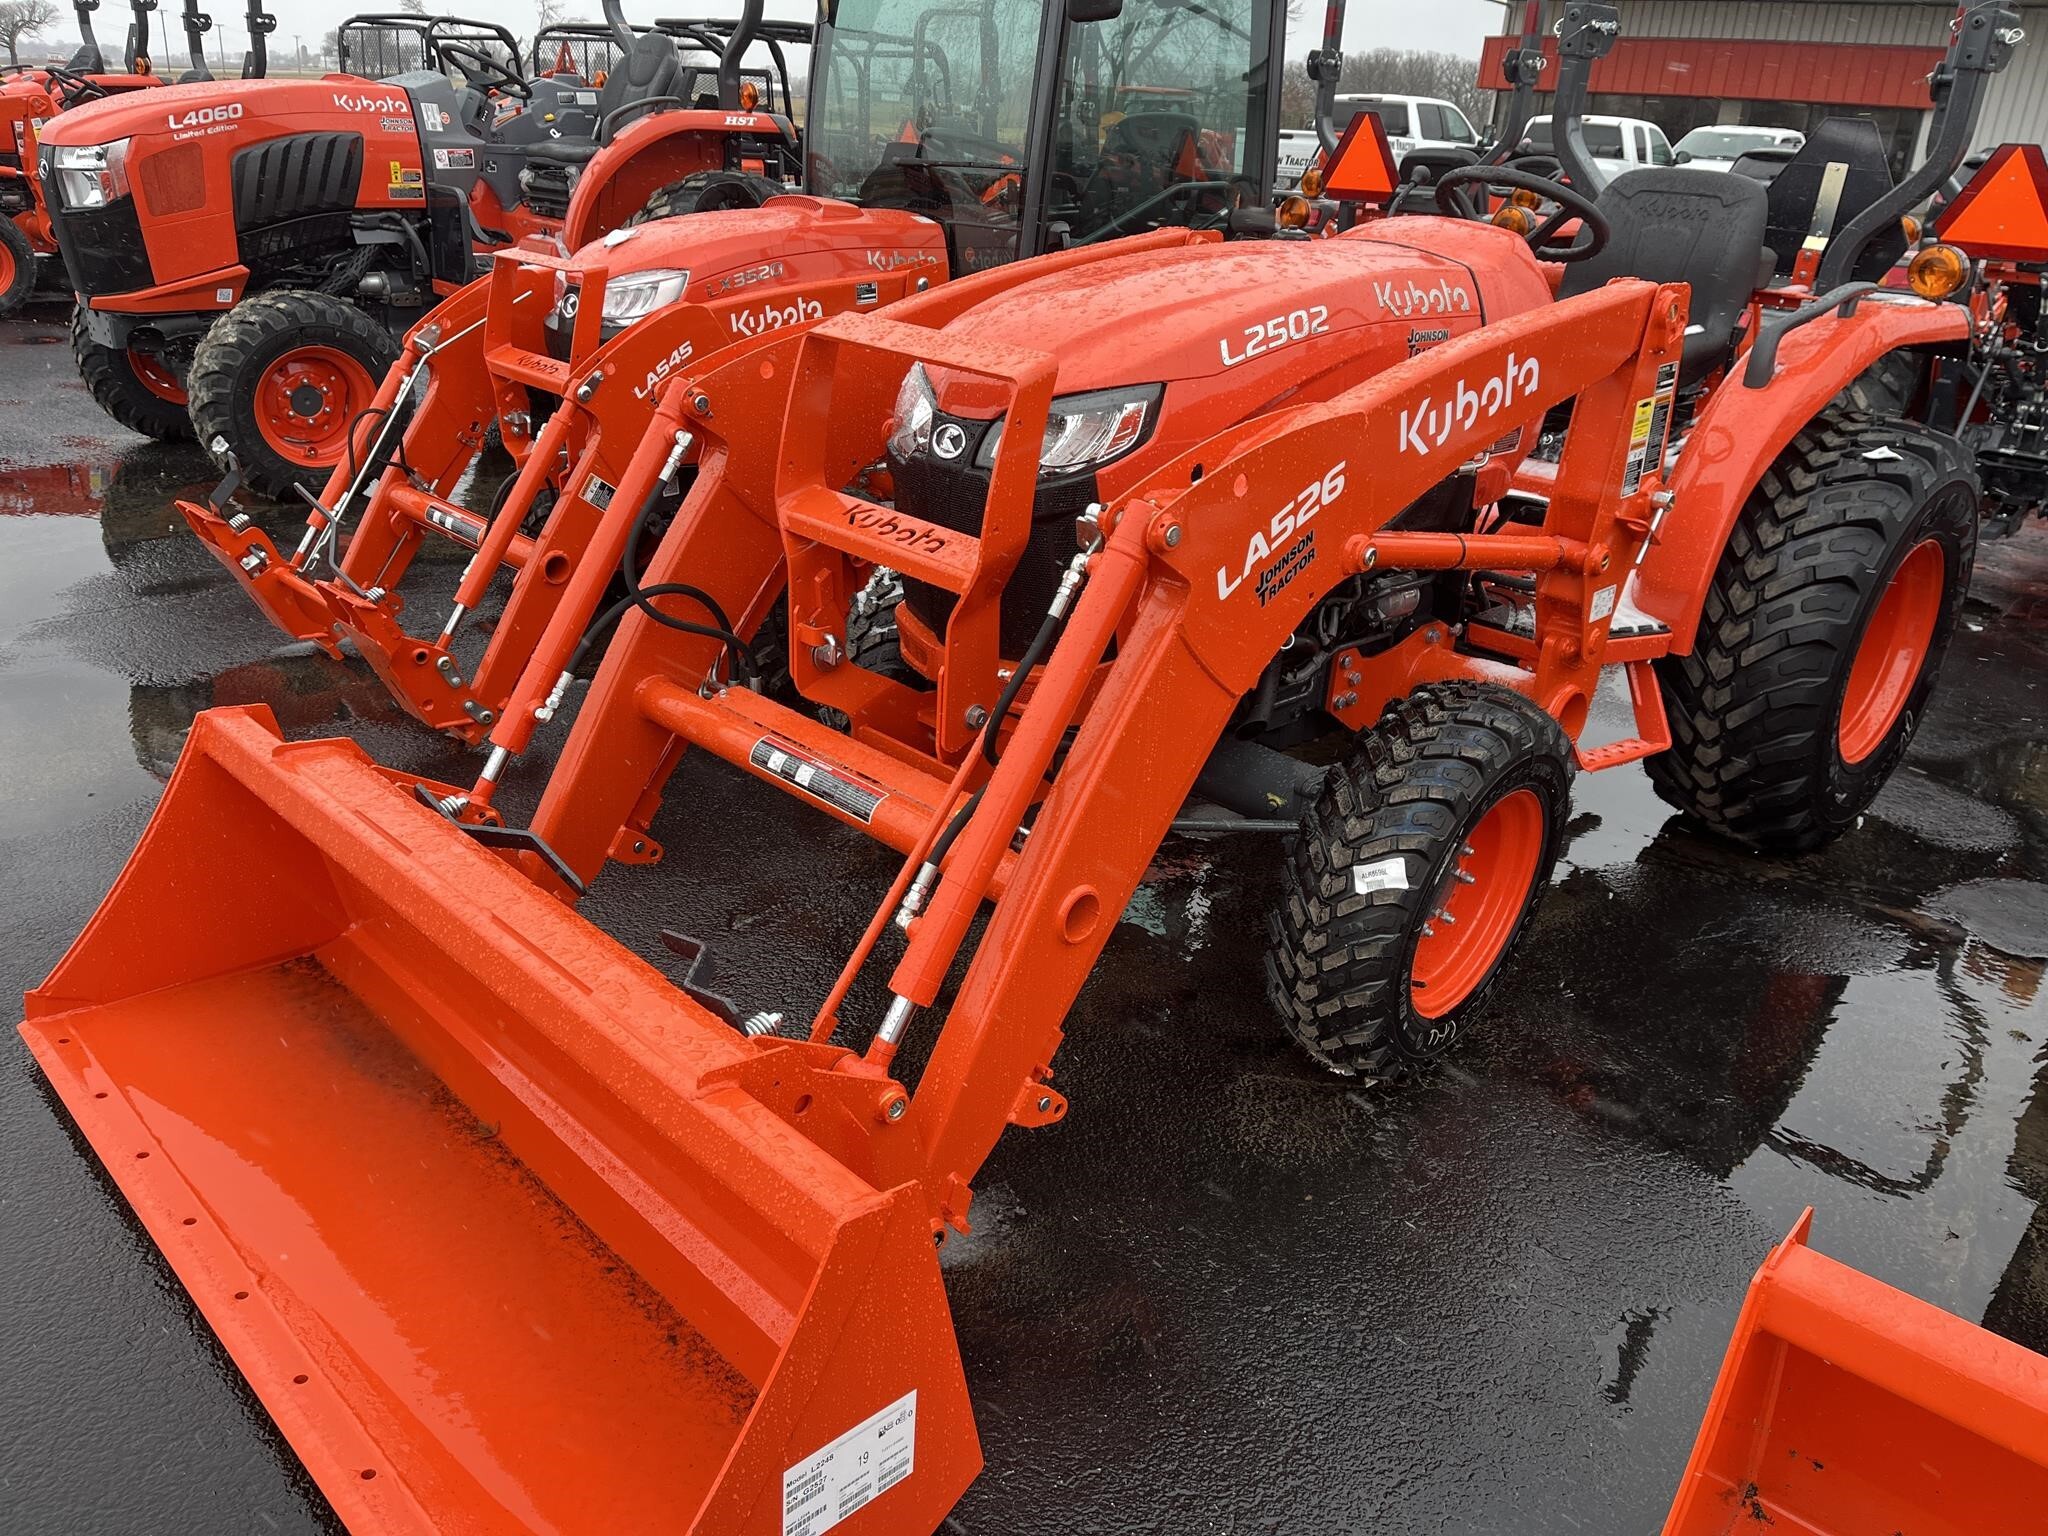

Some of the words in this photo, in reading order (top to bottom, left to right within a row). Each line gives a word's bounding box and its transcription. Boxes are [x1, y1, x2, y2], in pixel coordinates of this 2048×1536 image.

[168, 103, 243, 129] L4060
[333, 94, 408, 113] Kubota
[724, 116, 757, 126] HST
[173, 129, 205, 140] Limited
[207, 123, 238, 134] Edition
[1285, 154, 1319, 166] TRACTOR
[706, 262, 783, 298] LX3520
[1373, 278, 1469, 317] Kubota
[730, 296, 823, 336] Kubota
[1219, 304, 1329, 367] L2502
[1407, 329, 1449, 343] JOHNSON
[517, 354, 559, 374] Kubota
[633, 340, 693, 399] LA545
[1399, 352, 1540, 456] Kubota
[842, 503, 946, 554] Kubota
[1217, 460, 1346, 601] LA526
[1255, 529, 1314, 594] JOHNSON
[1258, 547, 1315, 608] TRACTOR
[858, 1451, 869, 1467] 19
[786, 1471, 807, 1488] Model
